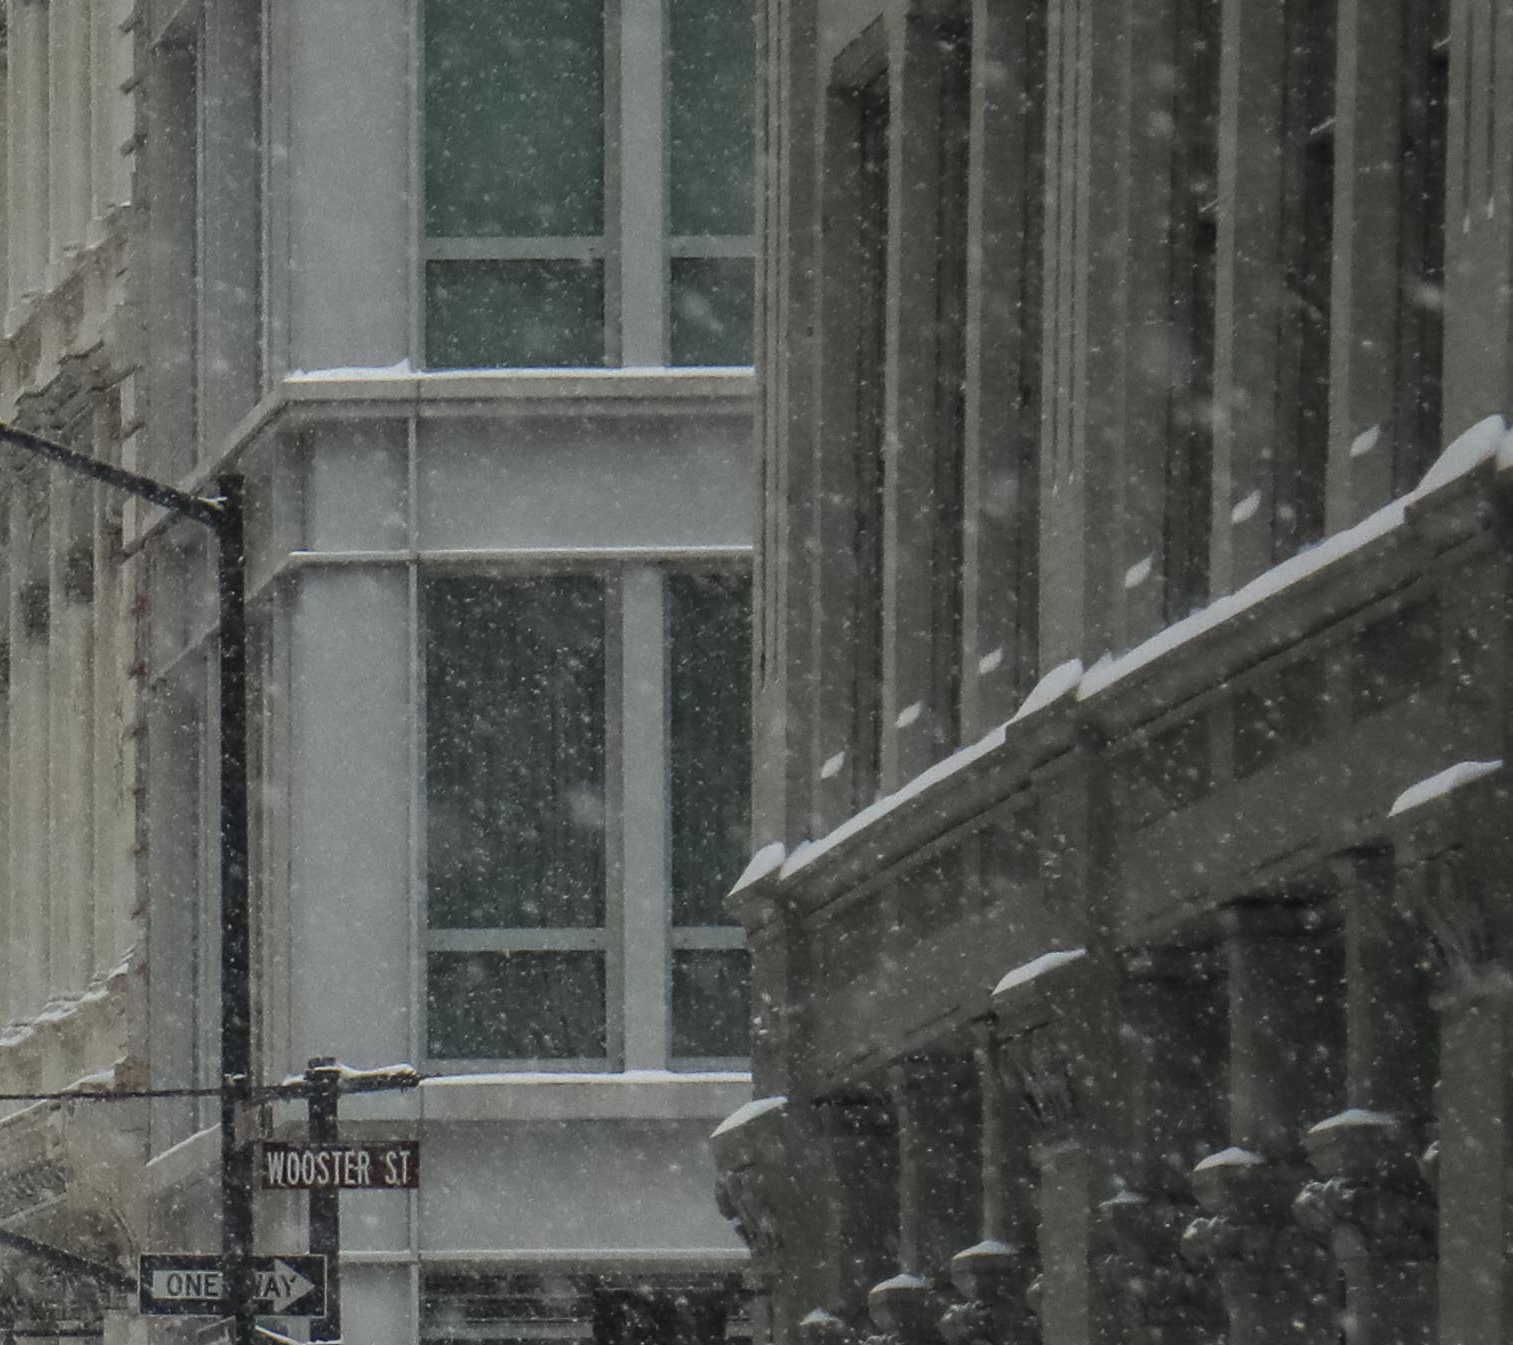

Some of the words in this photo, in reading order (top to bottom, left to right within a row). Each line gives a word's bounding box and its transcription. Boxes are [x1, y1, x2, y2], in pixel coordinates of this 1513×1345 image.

[267, 1151, 371, 1186] WOOSTER
[385, 1150, 411, 1186] ST
[167, 1272, 219, 1297] ONE
